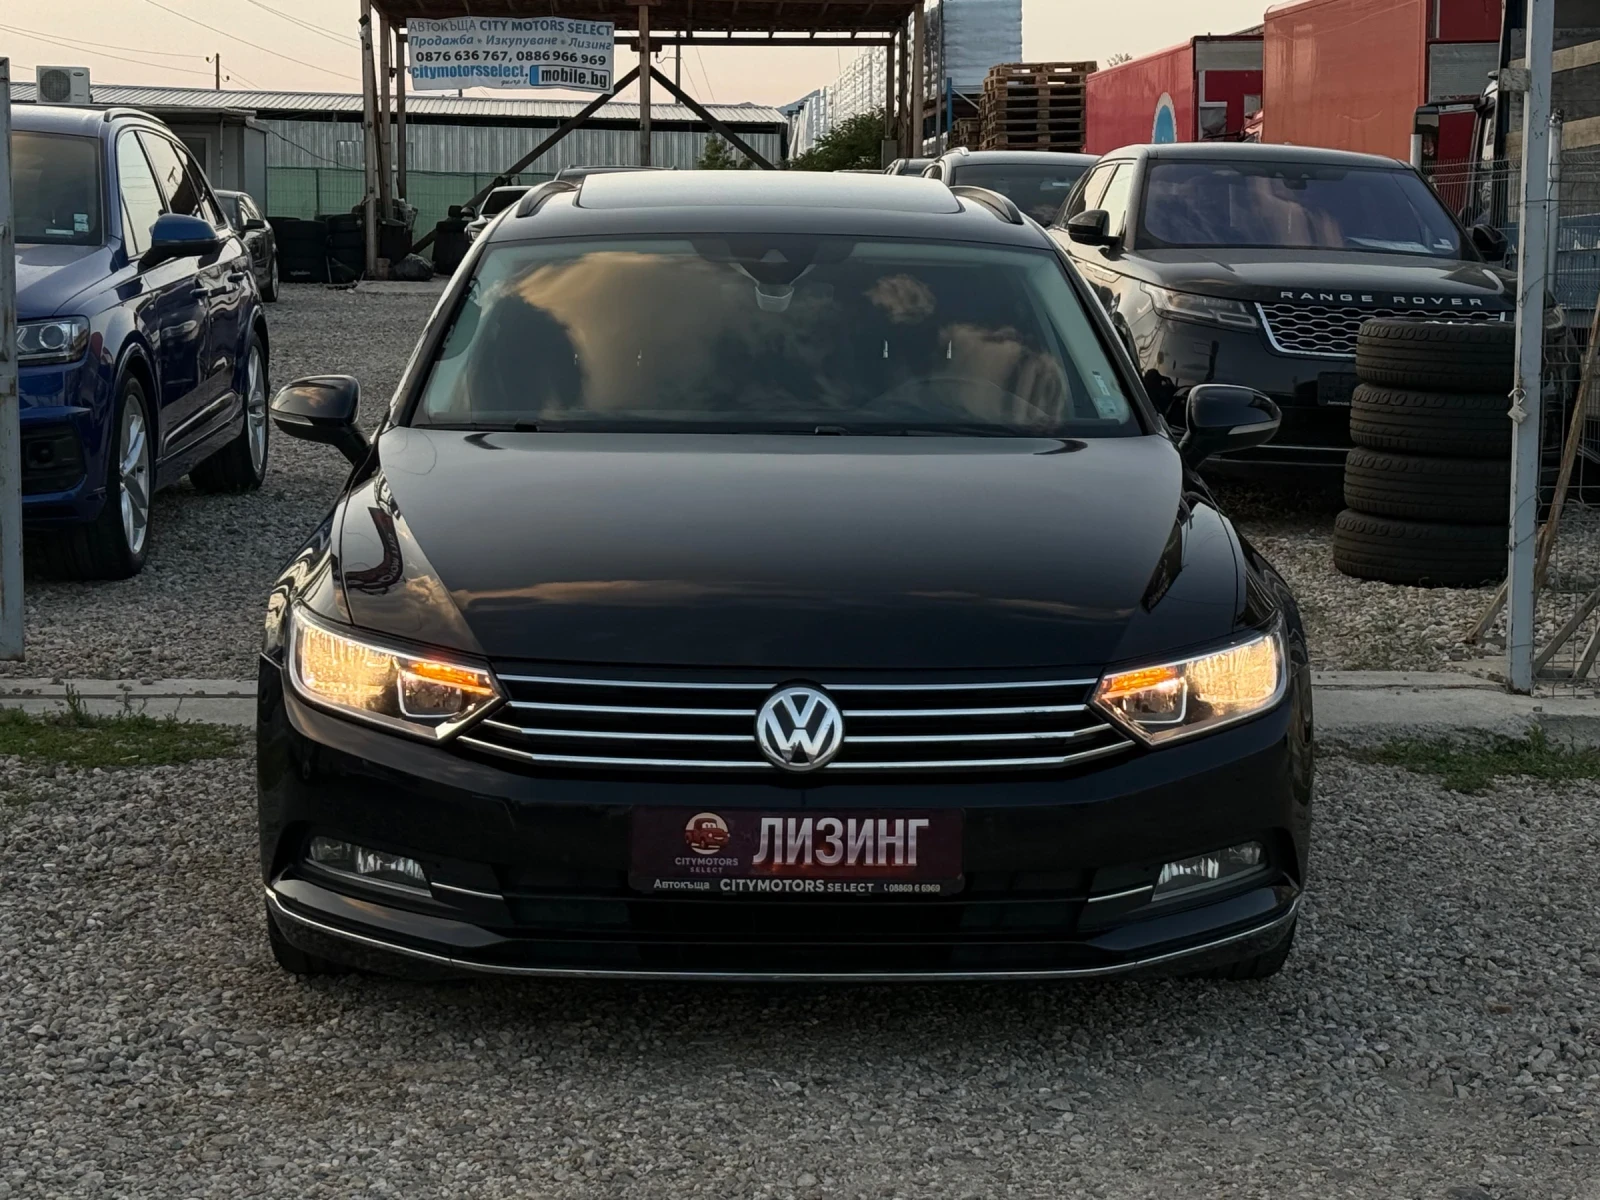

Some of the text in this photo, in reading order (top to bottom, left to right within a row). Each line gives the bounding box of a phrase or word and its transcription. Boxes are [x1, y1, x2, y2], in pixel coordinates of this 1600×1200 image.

[409, 20, 612, 36] АВТОКЪЩА CITY MOTORS SELECT
[410, 34, 612, 50] Продажба Изкупуване Лизинг
[415, 50, 606, 66] 0876 636 767, 0886 966 969
[541, 67, 607, 88] mobile.bg
[1281, 291, 1483, 306] RANGE ROVER
[752, 817, 929, 867] ЛИЗИНГ
[675, 857, 739, 866] CITYMOTORS
[653, 879, 710, 891] Автокъща
[720, 878, 824, 893] CITYMOTORS
[827, 883, 875, 893] SELECT
